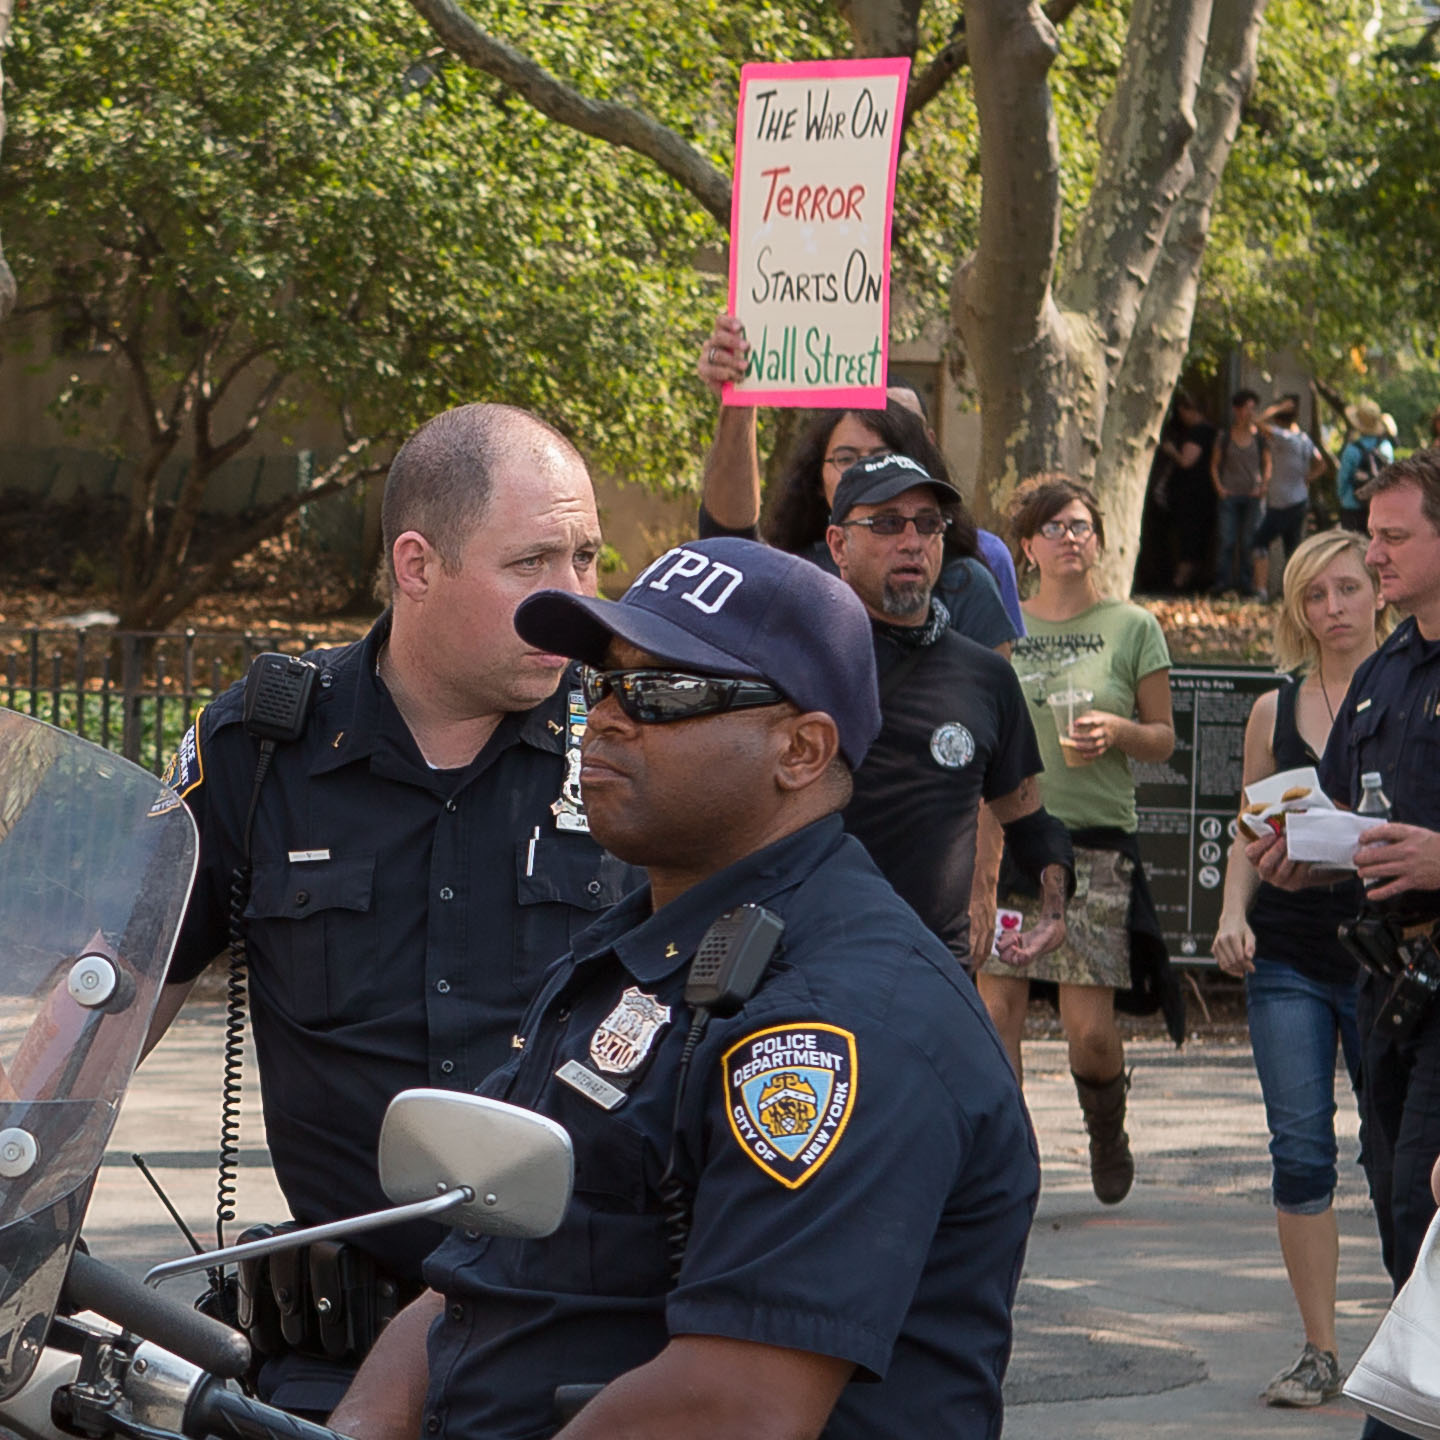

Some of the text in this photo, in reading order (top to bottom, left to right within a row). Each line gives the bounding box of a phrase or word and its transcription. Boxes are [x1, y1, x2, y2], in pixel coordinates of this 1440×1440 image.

[851, 88, 888, 138] ON
[752, 246, 881, 304] STARTS ON
[743, 326, 881, 386] Wall Street
[734, 1050, 843, 1088] DEPARTMENT
[752, 1034, 817, 1058] POLICE
[734, 1105, 777, 1161] CITY OF
[801, 1082, 848, 1165] NEW YORK
